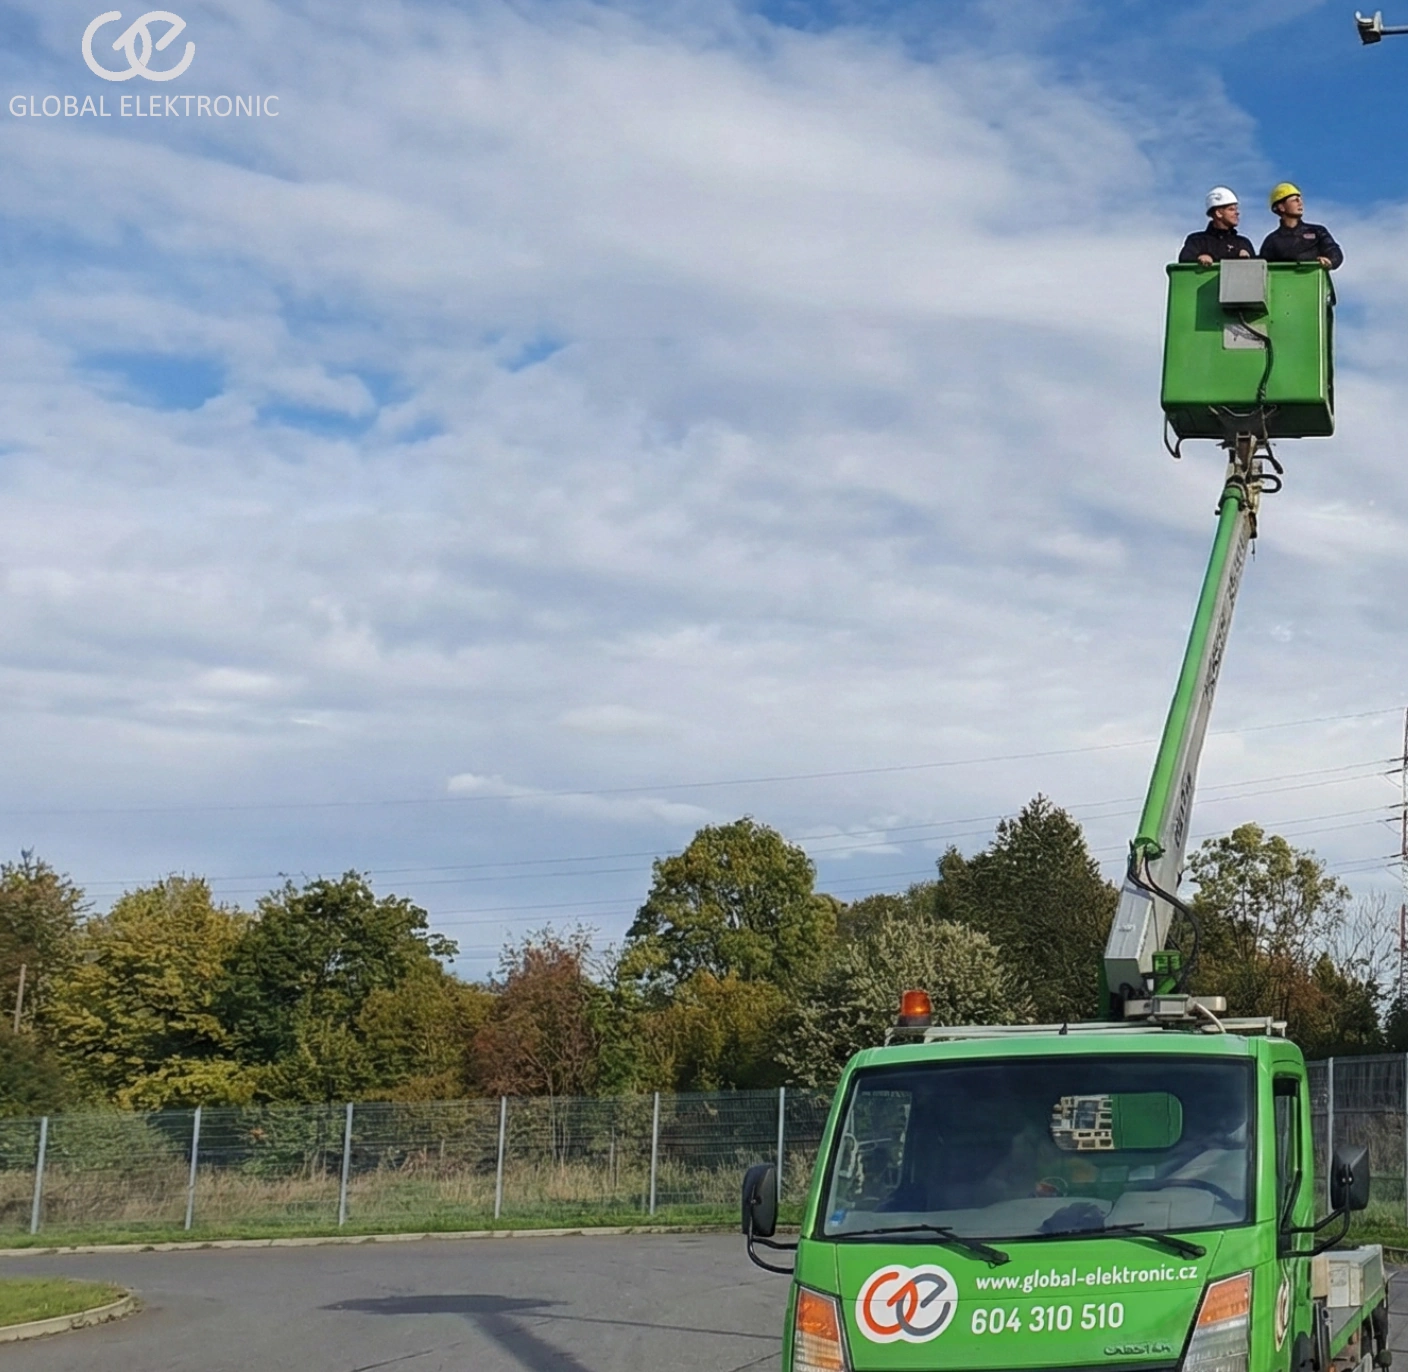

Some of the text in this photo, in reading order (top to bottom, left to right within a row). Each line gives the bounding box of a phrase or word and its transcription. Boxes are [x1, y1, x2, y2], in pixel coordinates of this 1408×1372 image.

[976, 1264, 1198, 1293] www.global-elektronic.cz
[971, 1302, 1124, 1335] 604 310 510
